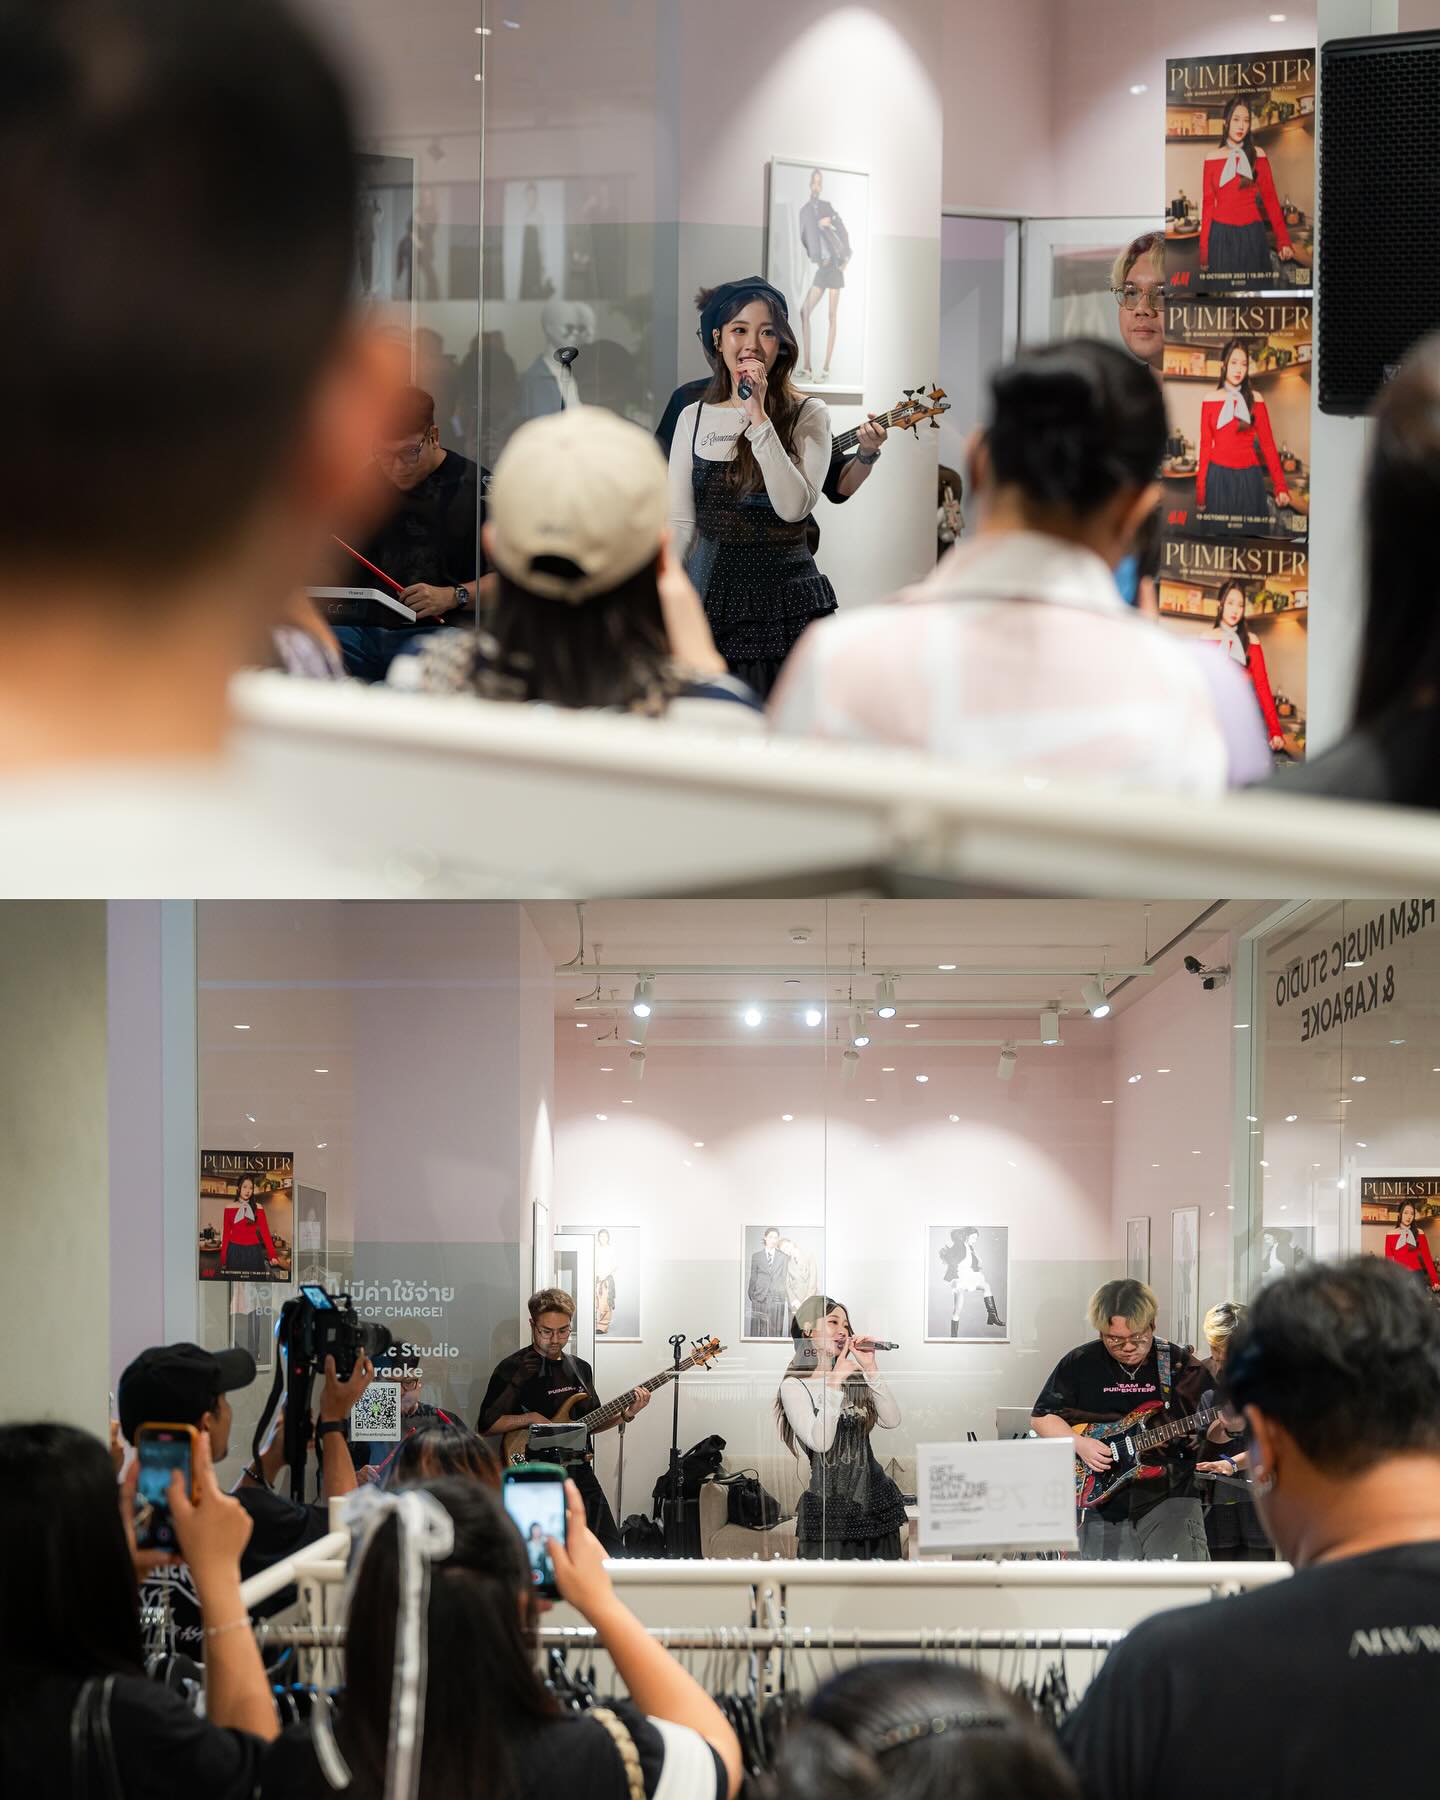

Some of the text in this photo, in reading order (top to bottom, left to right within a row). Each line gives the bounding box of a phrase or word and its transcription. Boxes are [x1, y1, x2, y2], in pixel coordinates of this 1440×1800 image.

[1169, 59, 1310, 91] PUIMEKSTER
[1169, 306, 1309, 330] PUIMEKSTER
[1166, 543, 1306, 576] PUIMEKSTER
[204, 1155, 291, 1170] PUIMEKSTER
[364, 1306, 382, 1317] OF
[385, 1306, 443, 1317] CHARGE!
[401, 1342, 459, 1357] Studio
[373, 1363, 424, 1378] raoke
